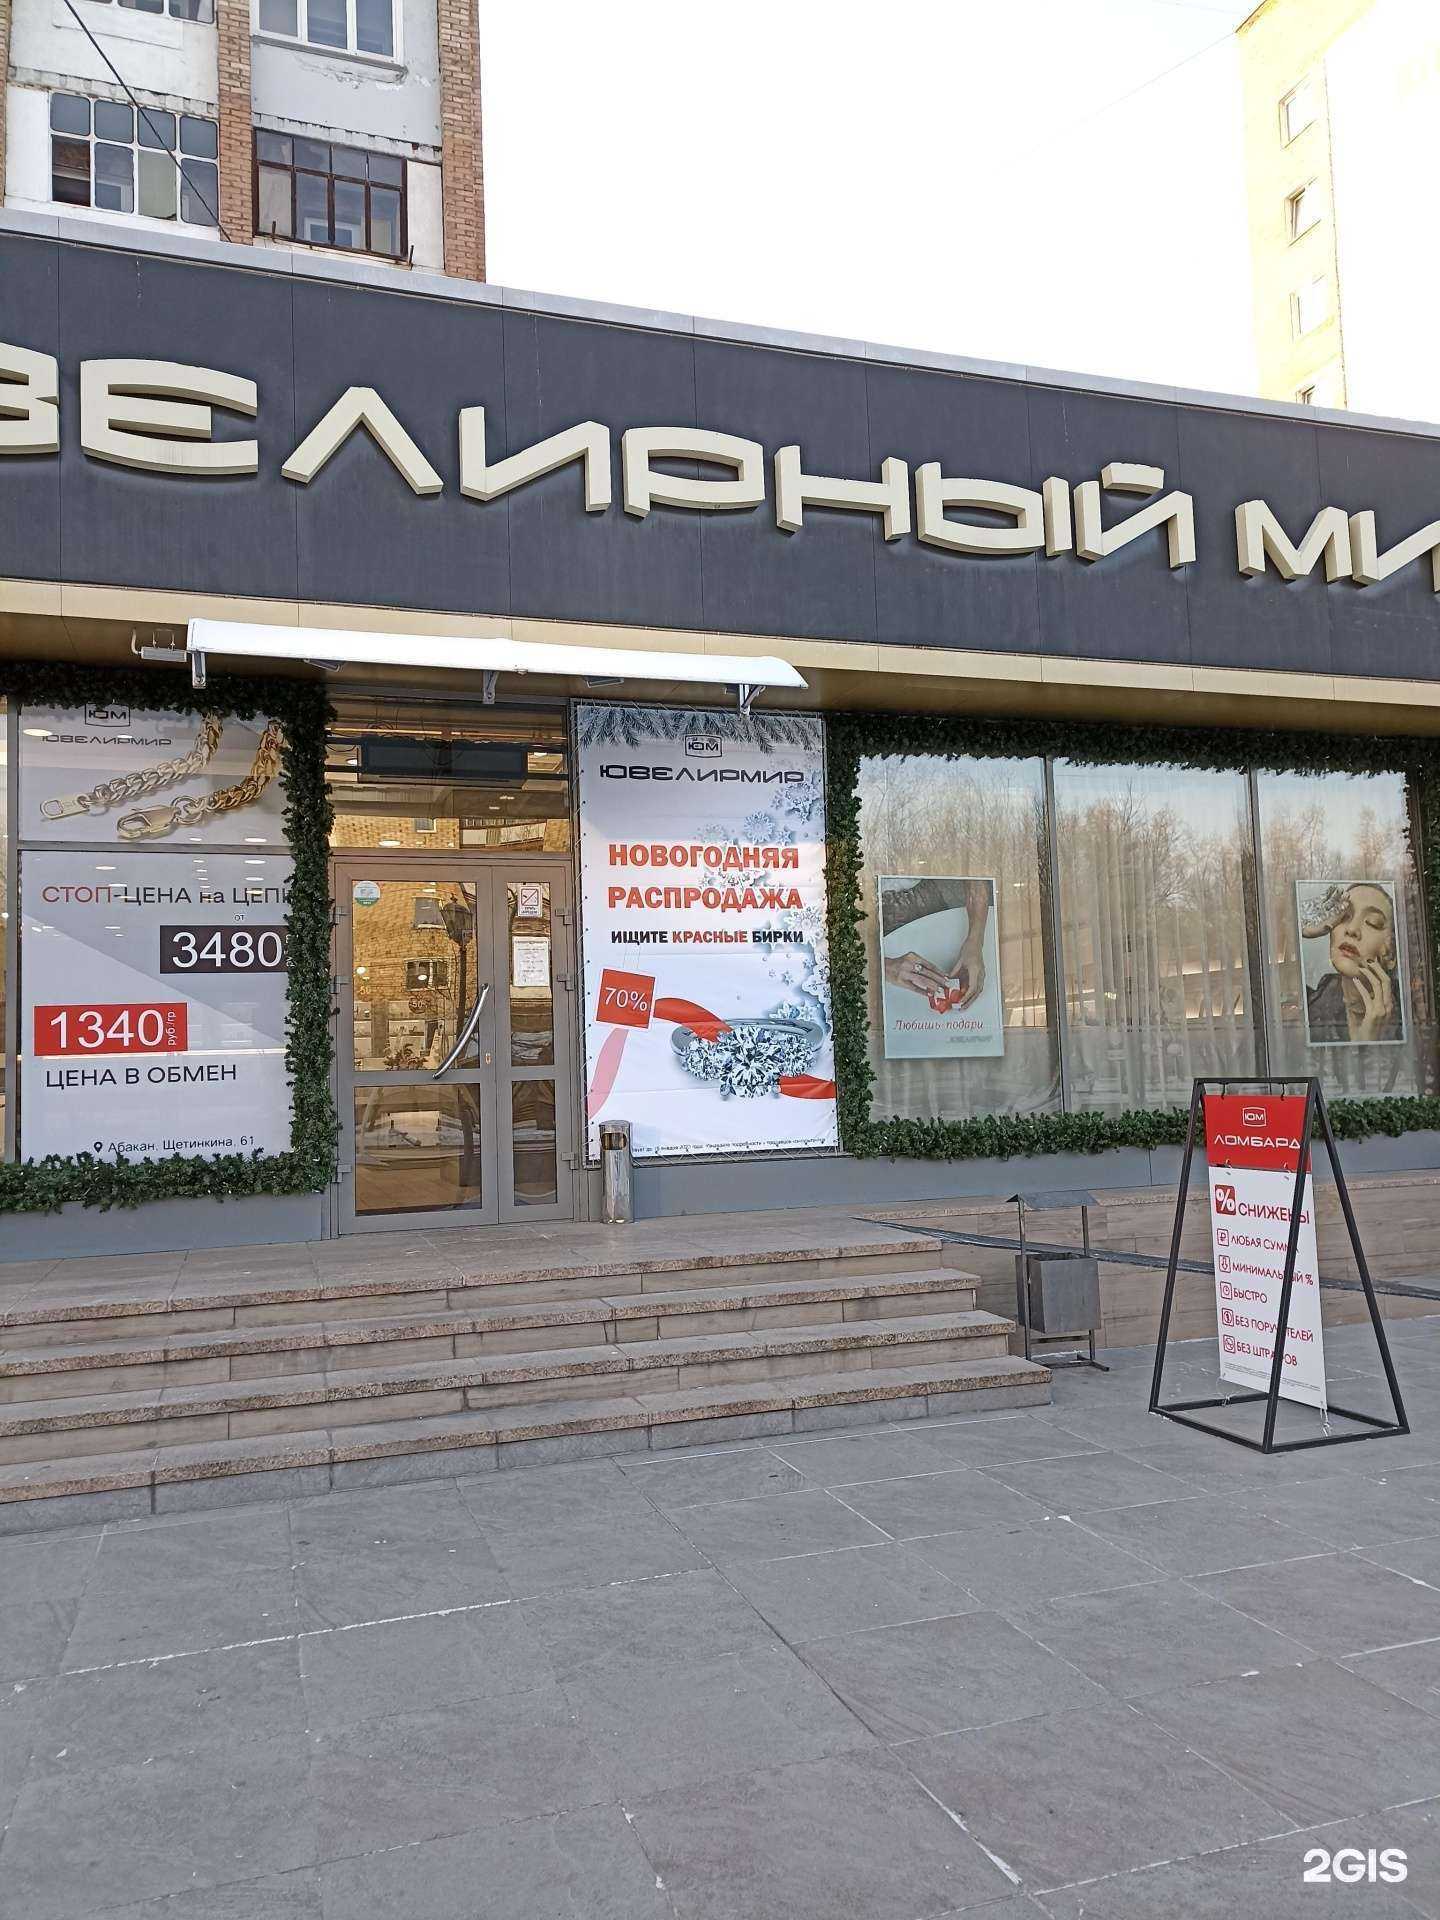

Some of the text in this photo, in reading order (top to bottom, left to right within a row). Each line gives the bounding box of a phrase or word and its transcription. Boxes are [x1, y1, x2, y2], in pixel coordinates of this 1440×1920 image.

[688, 742, 719, 751] ЮМ
[600, 764, 805, 783] ЮВЕЛИРМИР
[608, 844, 799, 872] НОВОГОДНЯЯ
[42, 886, 192, 906] СТОП-ЦЕНА
[608, 886, 804, 913] РАСПРОДАЖА
[611, 929, 804, 945] ИЩИТЕ КРАСНЫЕ БИРКИ
[172, 931, 282, 968] 3480
[605, 987, 648, 1012] 70%
[50, 1009, 164, 1049] 1340
[46, 1065, 237, 1090] ЦЕНА В ОБМЕН
[1244, 1112, 1264, 1121] ЮМ
[240, 1136, 255, 1146] 61
[1214, 1134, 1301, 1149] ЛОМБАРД
[1238, 1202, 1310, 1224] СНИЖЕЫ
[1231, 1235, 1299, 1253] ЛЮБАЯ СУМ
[1232, 1263, 1303, 1284] МИНИМАЛЬЫЙ
[1233, 1287, 1268, 1304] БЫСТРО
[1235, 1315, 1314, 1343] БЕЗ ПОРУТЕЛЕЙ
[1236, 1341, 1298, 1366] БЕЗ ШТРАОВ
